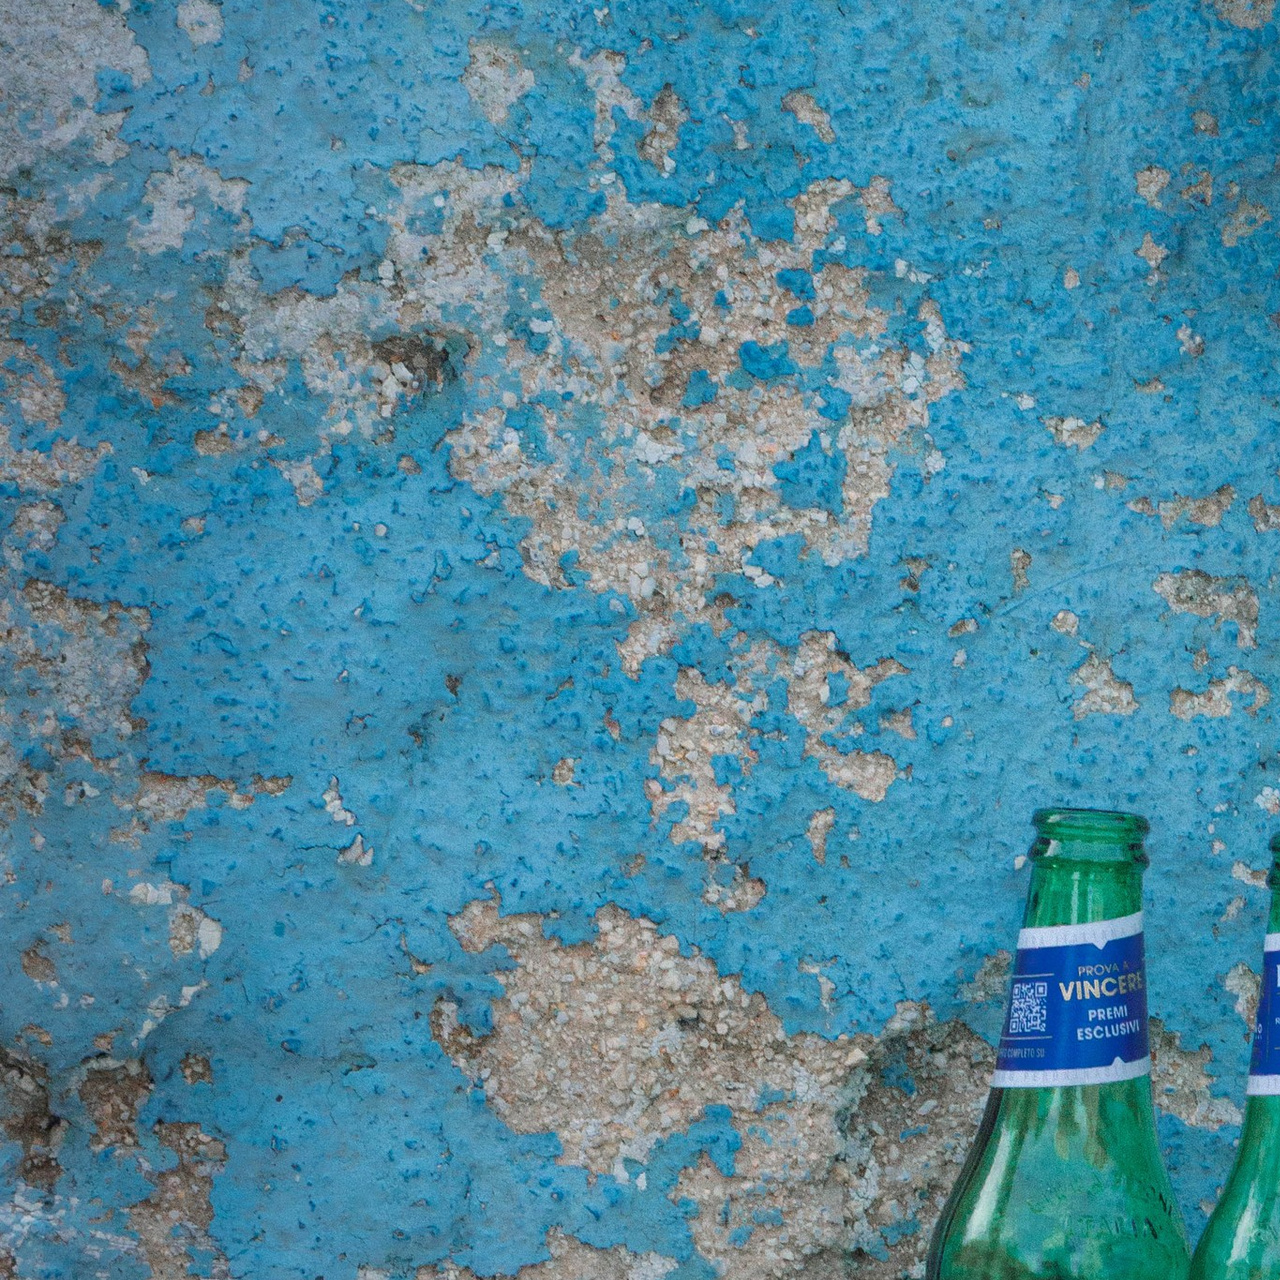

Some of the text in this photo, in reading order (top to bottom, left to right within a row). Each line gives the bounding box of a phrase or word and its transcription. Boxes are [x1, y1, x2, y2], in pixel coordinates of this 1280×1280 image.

[1078, 963, 1119, 977] PROVA
[1059, 971, 1143, 1001] VINCERE
[1088, 1005, 1128, 1022] PREMI
[1077, 1019, 1140, 1041] ESCLUSIVI
